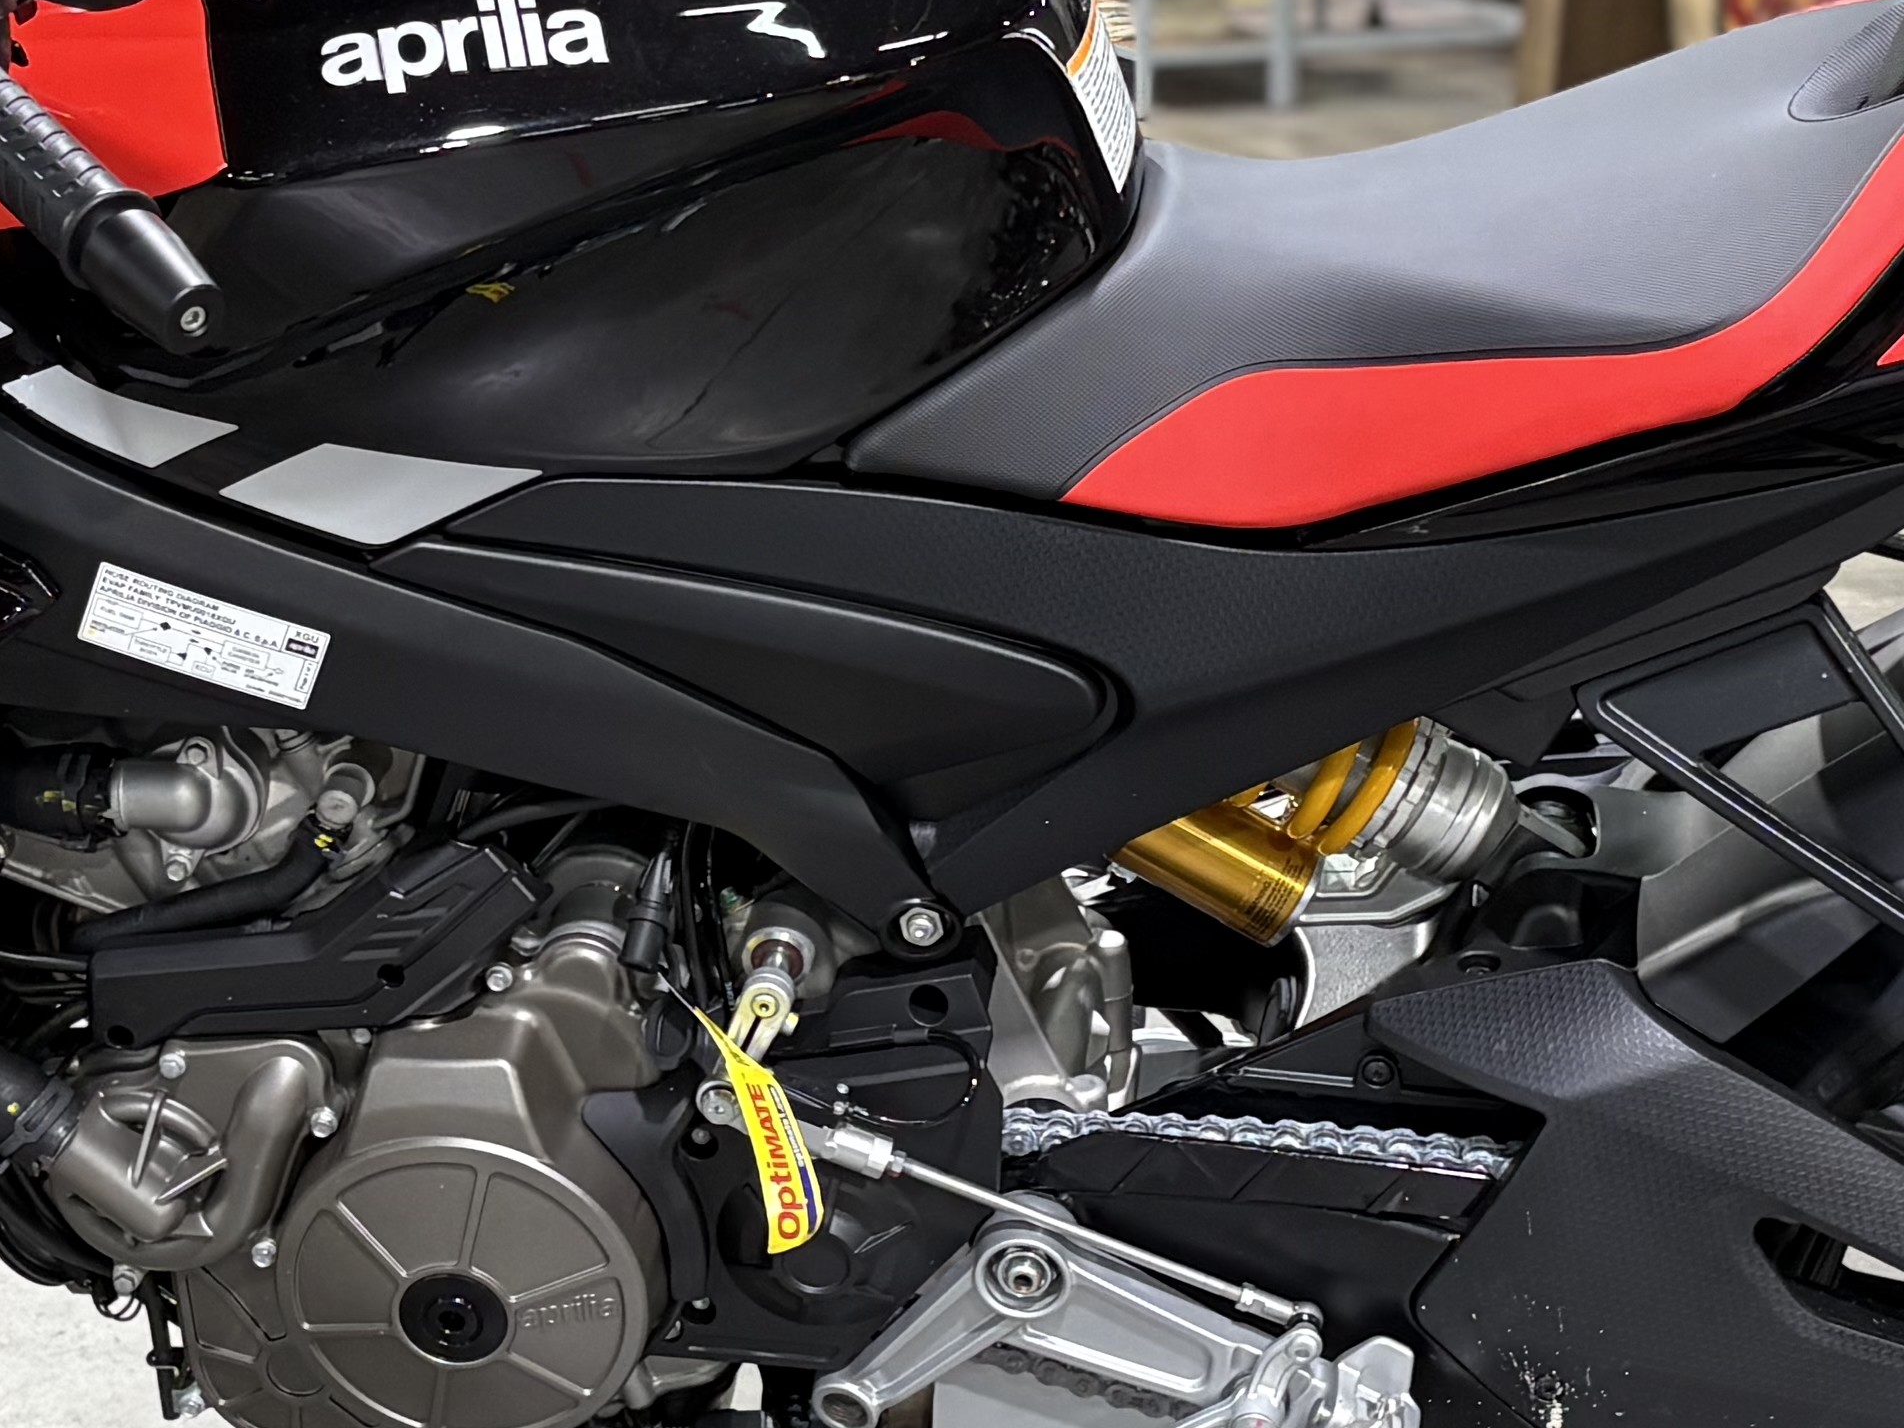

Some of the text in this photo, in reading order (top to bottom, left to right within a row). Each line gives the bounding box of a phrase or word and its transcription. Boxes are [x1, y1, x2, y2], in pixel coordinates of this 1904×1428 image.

[133, 578, 174, 597] ROUTING
[176, 593, 219, 611] DIAGRAM
[295, 630, 319, 644] XGU
[746, 1083, 803, 1240] OptiMATE
[520, 1292, 615, 1331] aprilia
